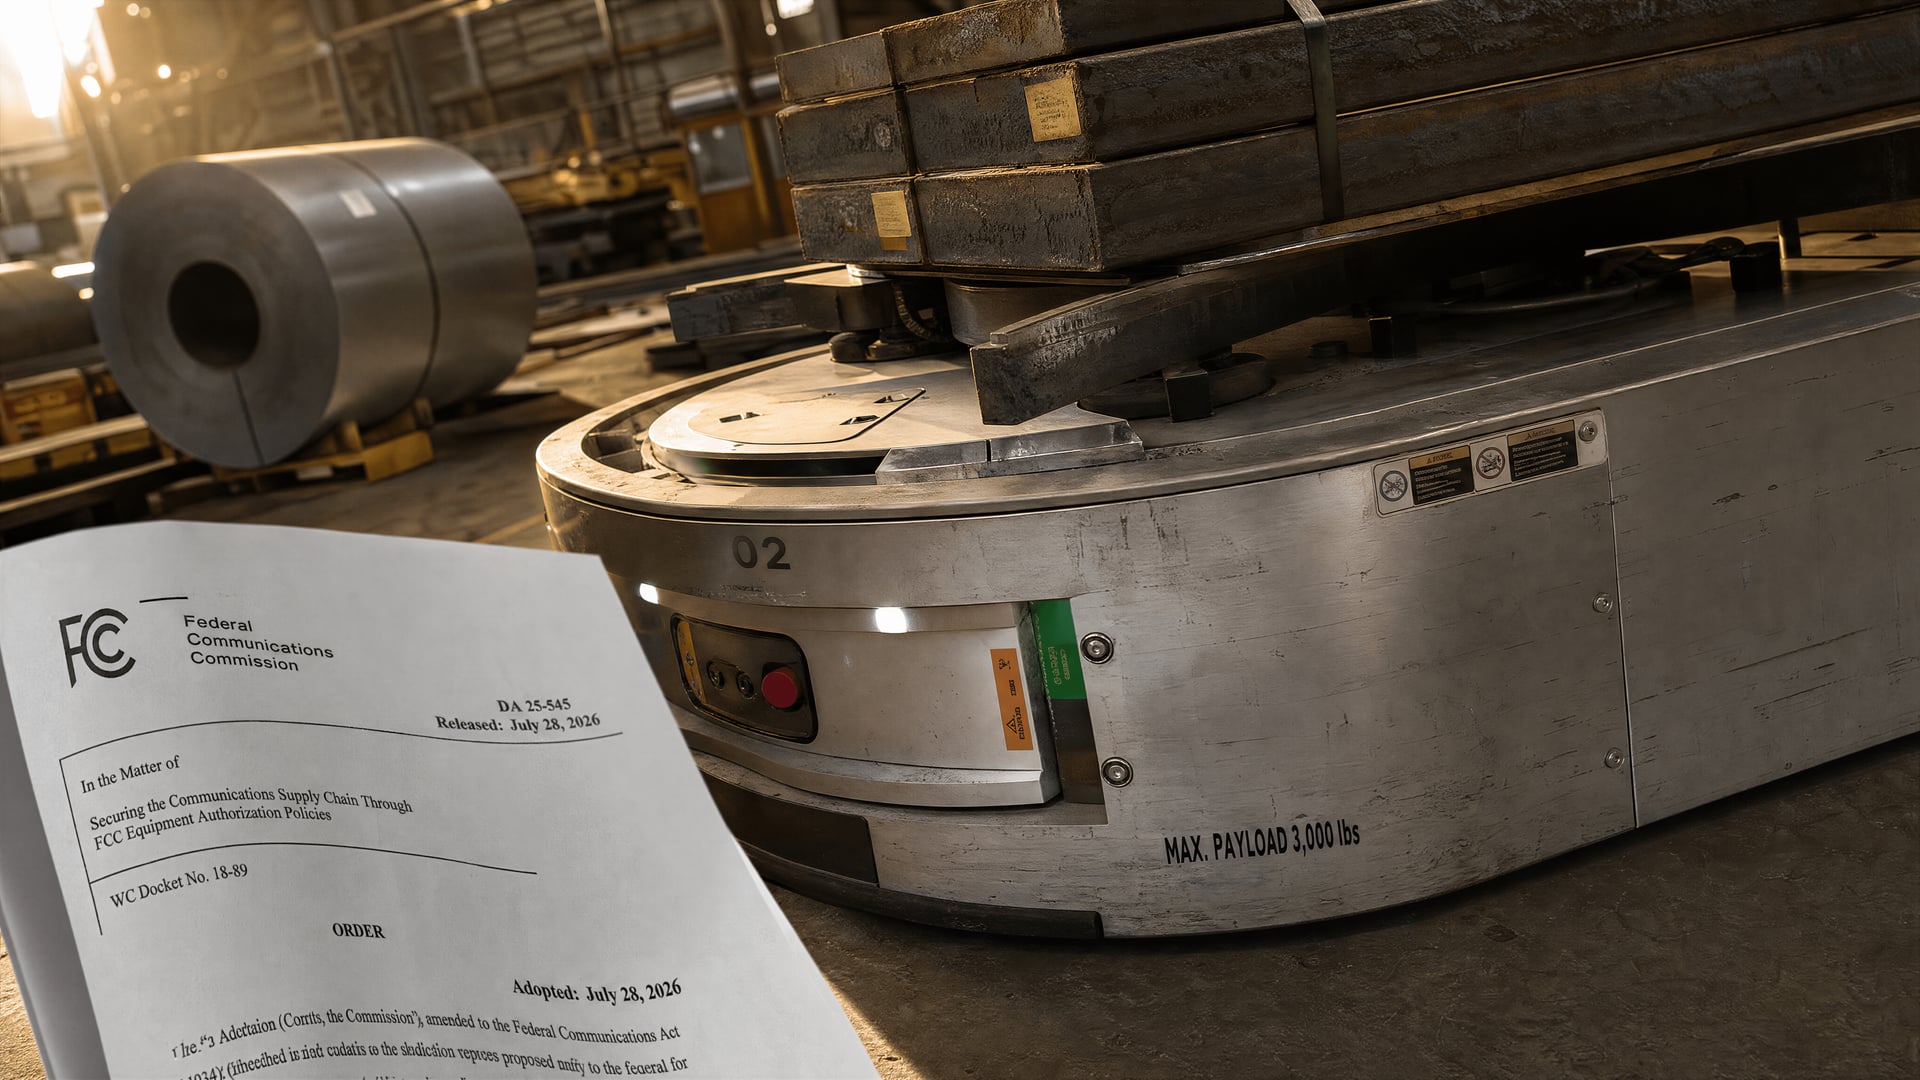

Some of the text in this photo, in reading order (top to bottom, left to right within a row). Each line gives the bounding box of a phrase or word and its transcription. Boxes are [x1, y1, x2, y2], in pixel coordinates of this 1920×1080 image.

[732, 536, 791, 569] 02
[184, 615, 253, 632] Federal
[59, 608, 136, 688] FCC
[187, 632, 334, 658] Communications
[191, 652, 299, 671] Commission
[496, 698, 571, 712] DA 25-545
[435, 713, 600, 734] Released: July 28, 2026
[81, 755, 180, 794] In the Matter of
[90, 787, 414, 831] Securing the Communications Supply Chain Through
[94, 805, 332, 850] FCC Equipment Authorization Policies
[1164, 819, 1360, 864] MAX. PAYLOAD 3,000 lbs
[110, 863, 248, 909] WC Docket No. 18-89
[332, 922, 386, 941] ORDER
[514, 978, 682, 1006] Adopted: July 28, 2026
[327, 1009, 344, 1024] the
[426, 1013, 475, 1028] amended
[477, 1018, 490, 1031] to
[492, 1018, 511, 1033] the
[512, 1020, 557, 1039] Federal
[558, 1025, 657, 1043] Communications
[660, 1026, 681, 1040] Act
[381, 1041, 398, 1056] the
[501, 1054, 555, 1069] proposed
[588, 1060, 601, 1075] to
[603, 1057, 622, 1076] the
[670, 1055, 688, 1072] for
